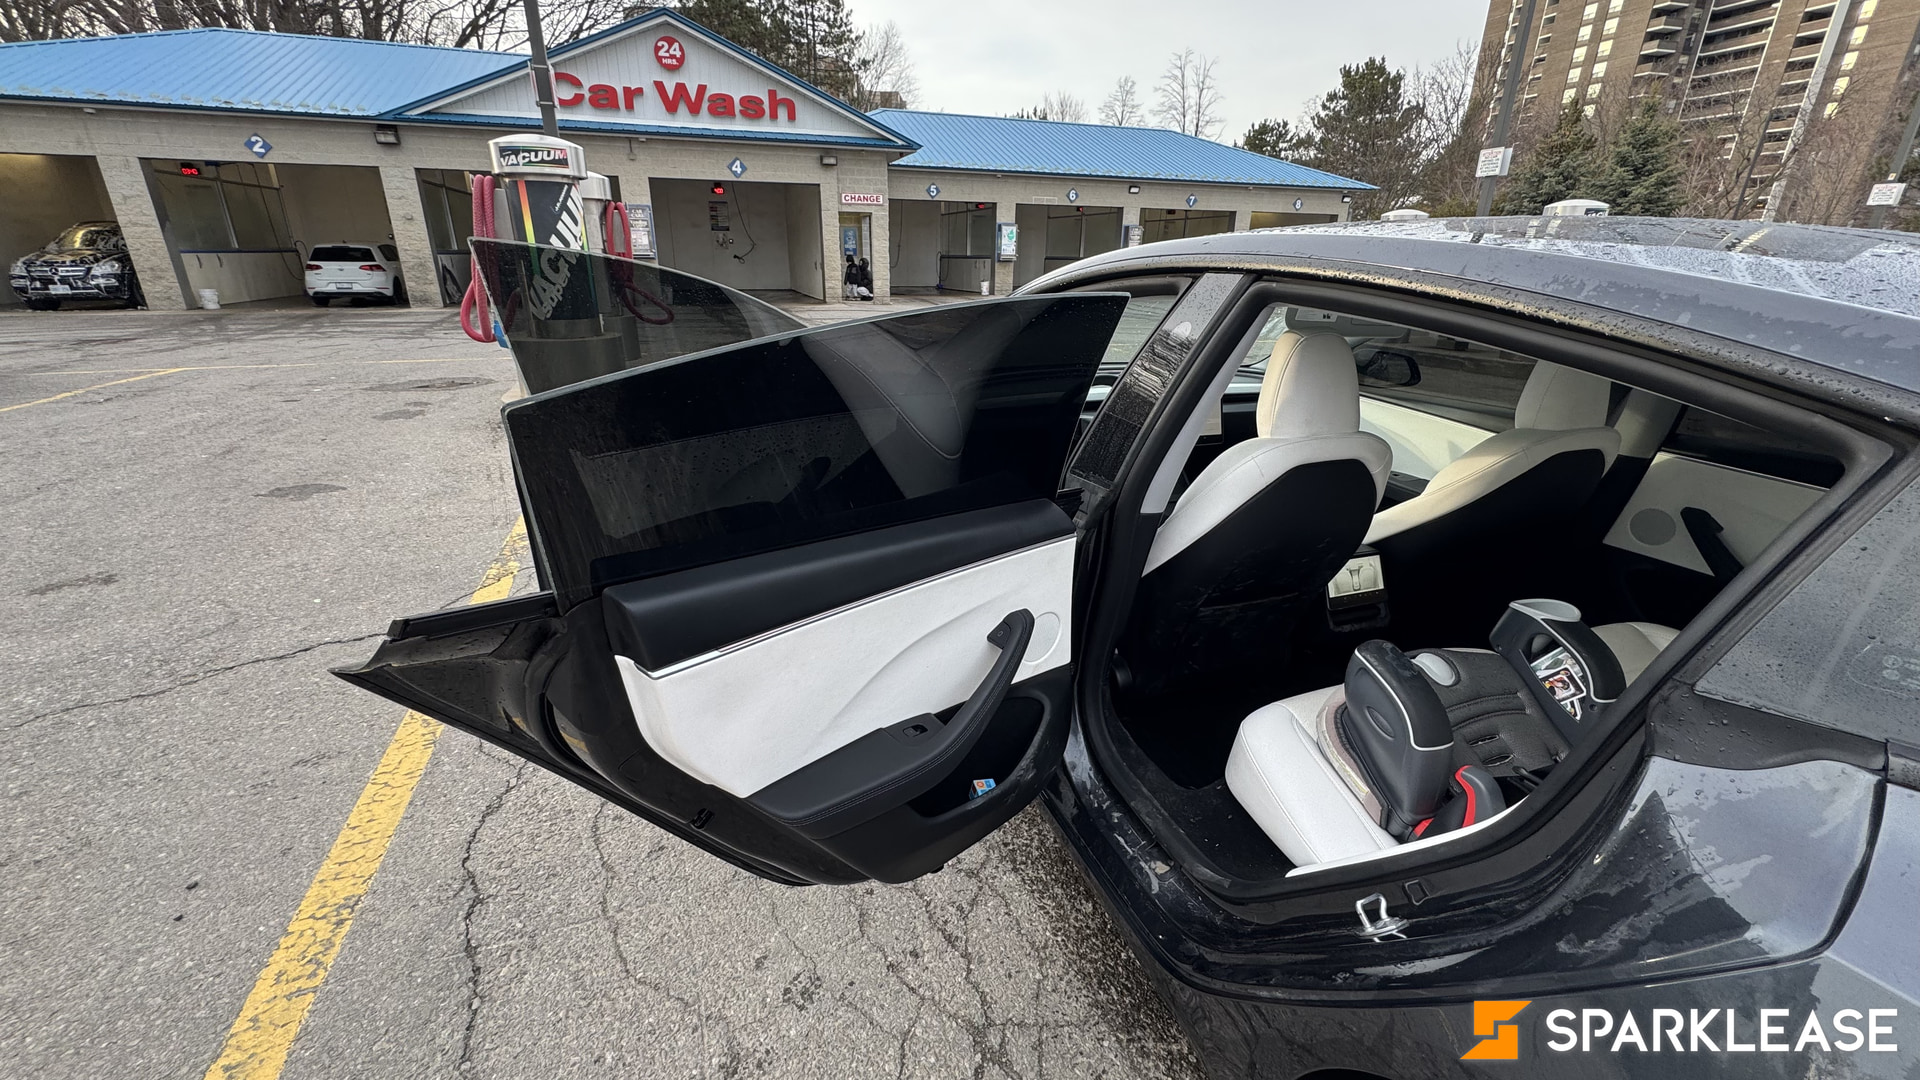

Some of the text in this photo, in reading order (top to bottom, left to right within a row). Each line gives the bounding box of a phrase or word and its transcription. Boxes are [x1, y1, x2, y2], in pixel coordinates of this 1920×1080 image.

[657, 40, 682, 58] 24
[661, 57, 680, 66] HRS.
[554, 72, 797, 121] Car Wash
[250, 135, 266, 153] 2
[500, 149, 567, 167] VACUUM
[731, 159, 742, 174] 4
[929, 185, 937, 196] 5
[1069, 189, 1077, 201] 6
[843, 194, 881, 203] CHANGE
[1189, 195, 1196, 206] 7
[1295, 199, 1302, 209] 8
